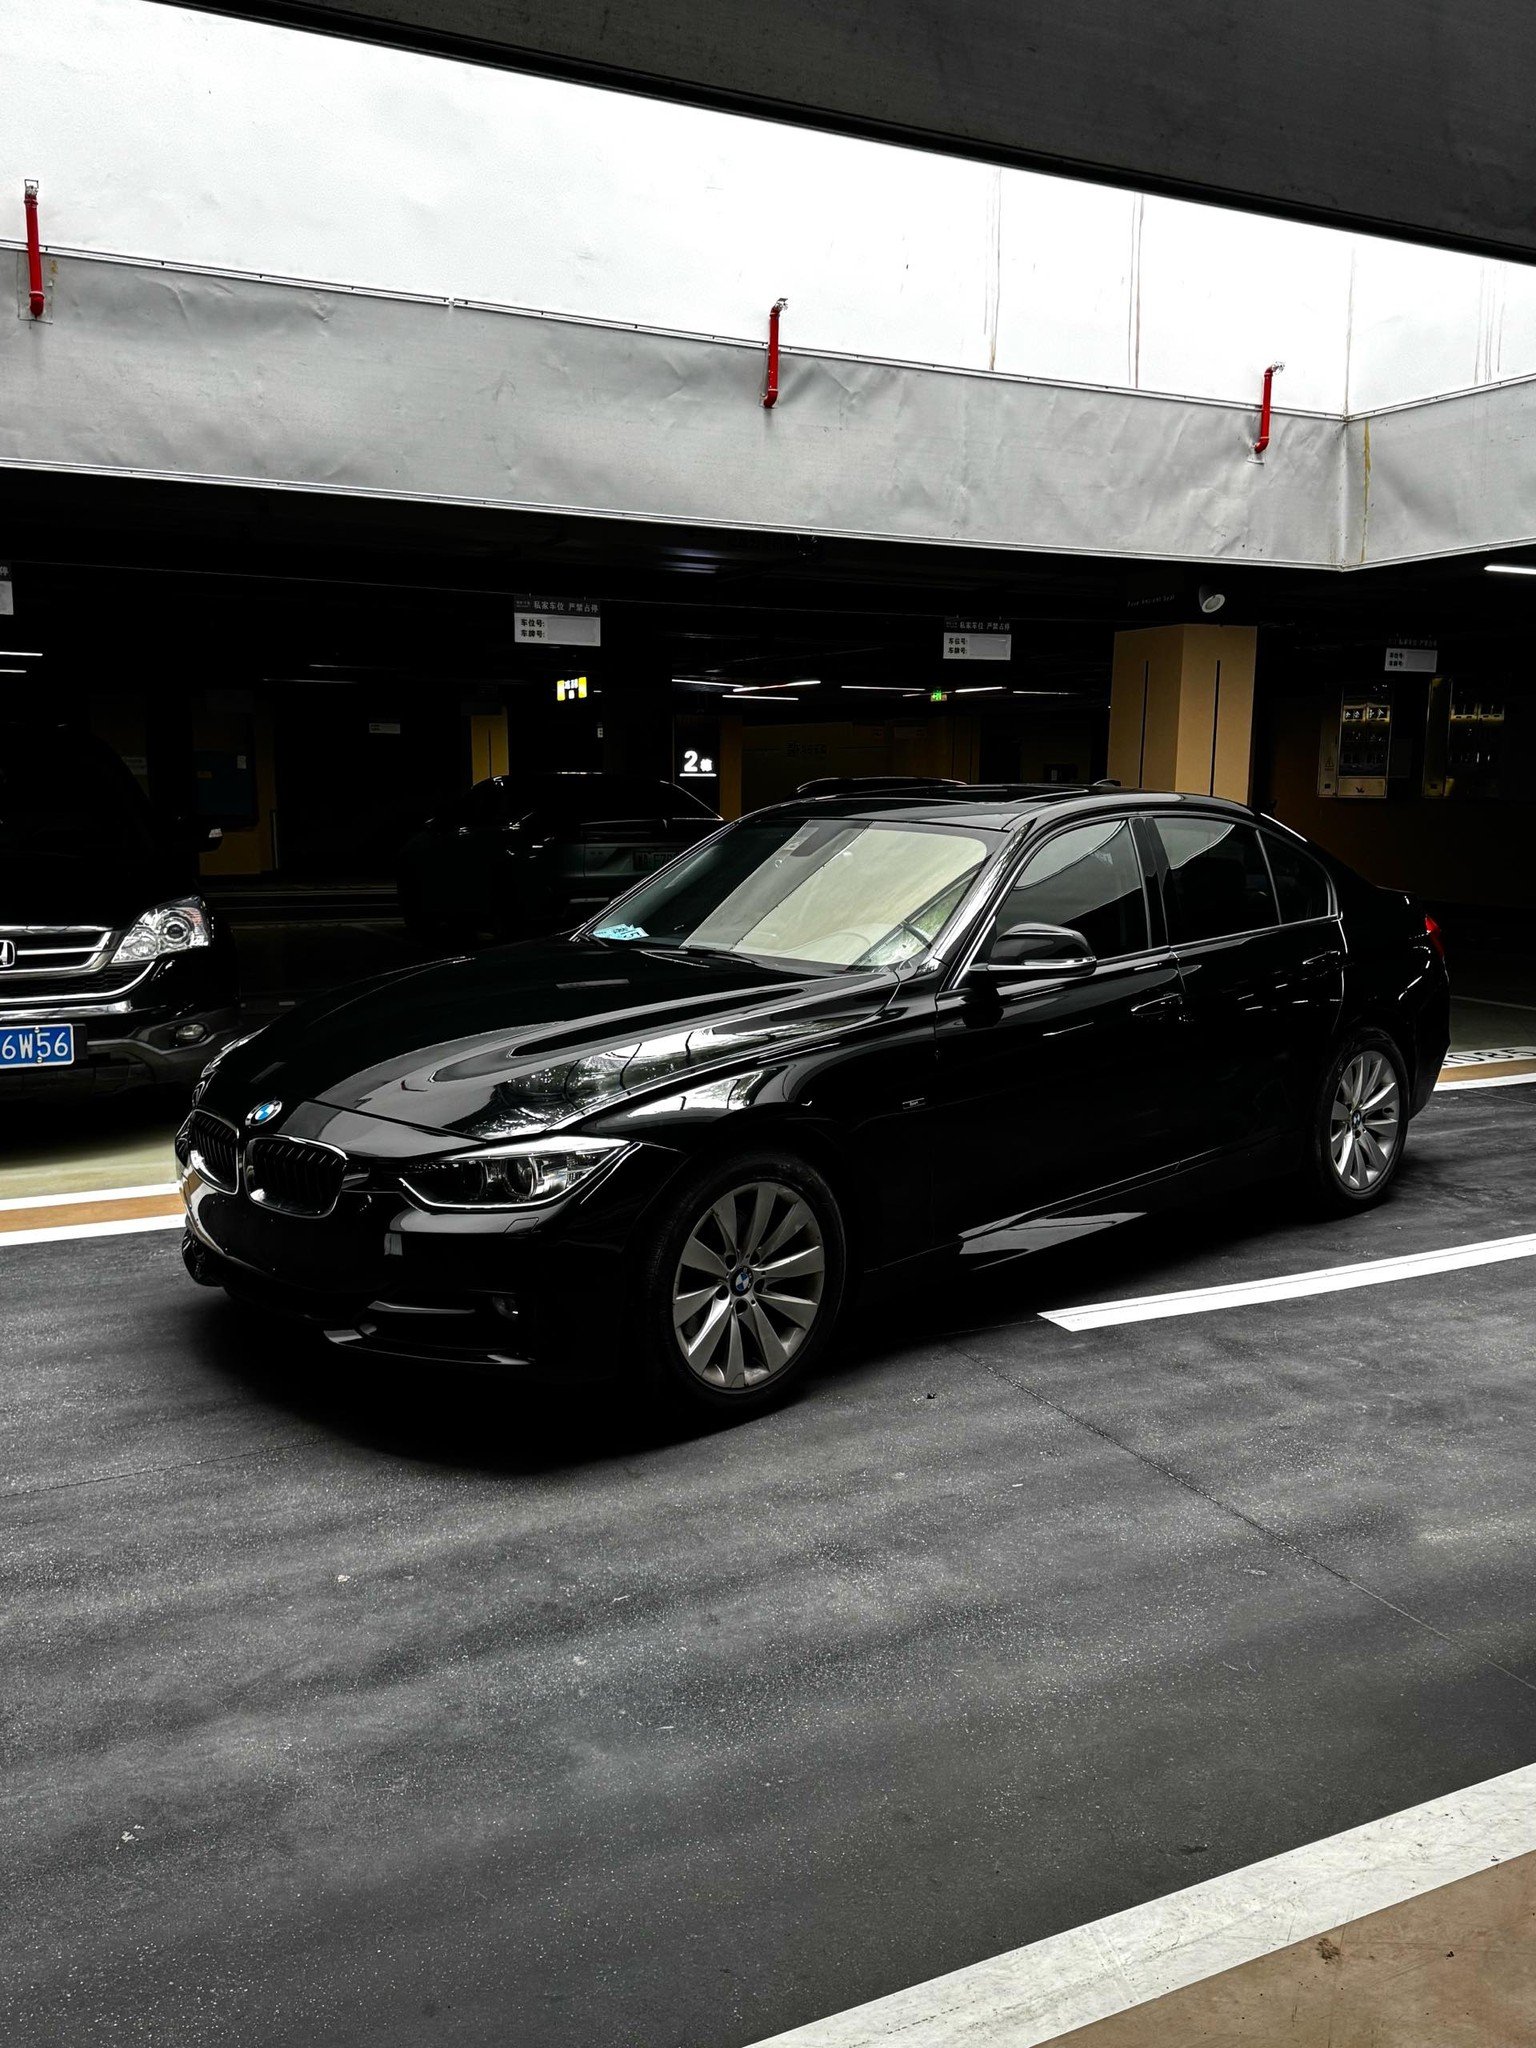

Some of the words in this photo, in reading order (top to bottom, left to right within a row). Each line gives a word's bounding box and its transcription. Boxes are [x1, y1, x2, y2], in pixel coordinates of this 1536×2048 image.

[533, 600, 565, 611] 私家车位
[568, 602, 599, 613] 严禁占停
[1, 1032, 68, 1060] 6W56
